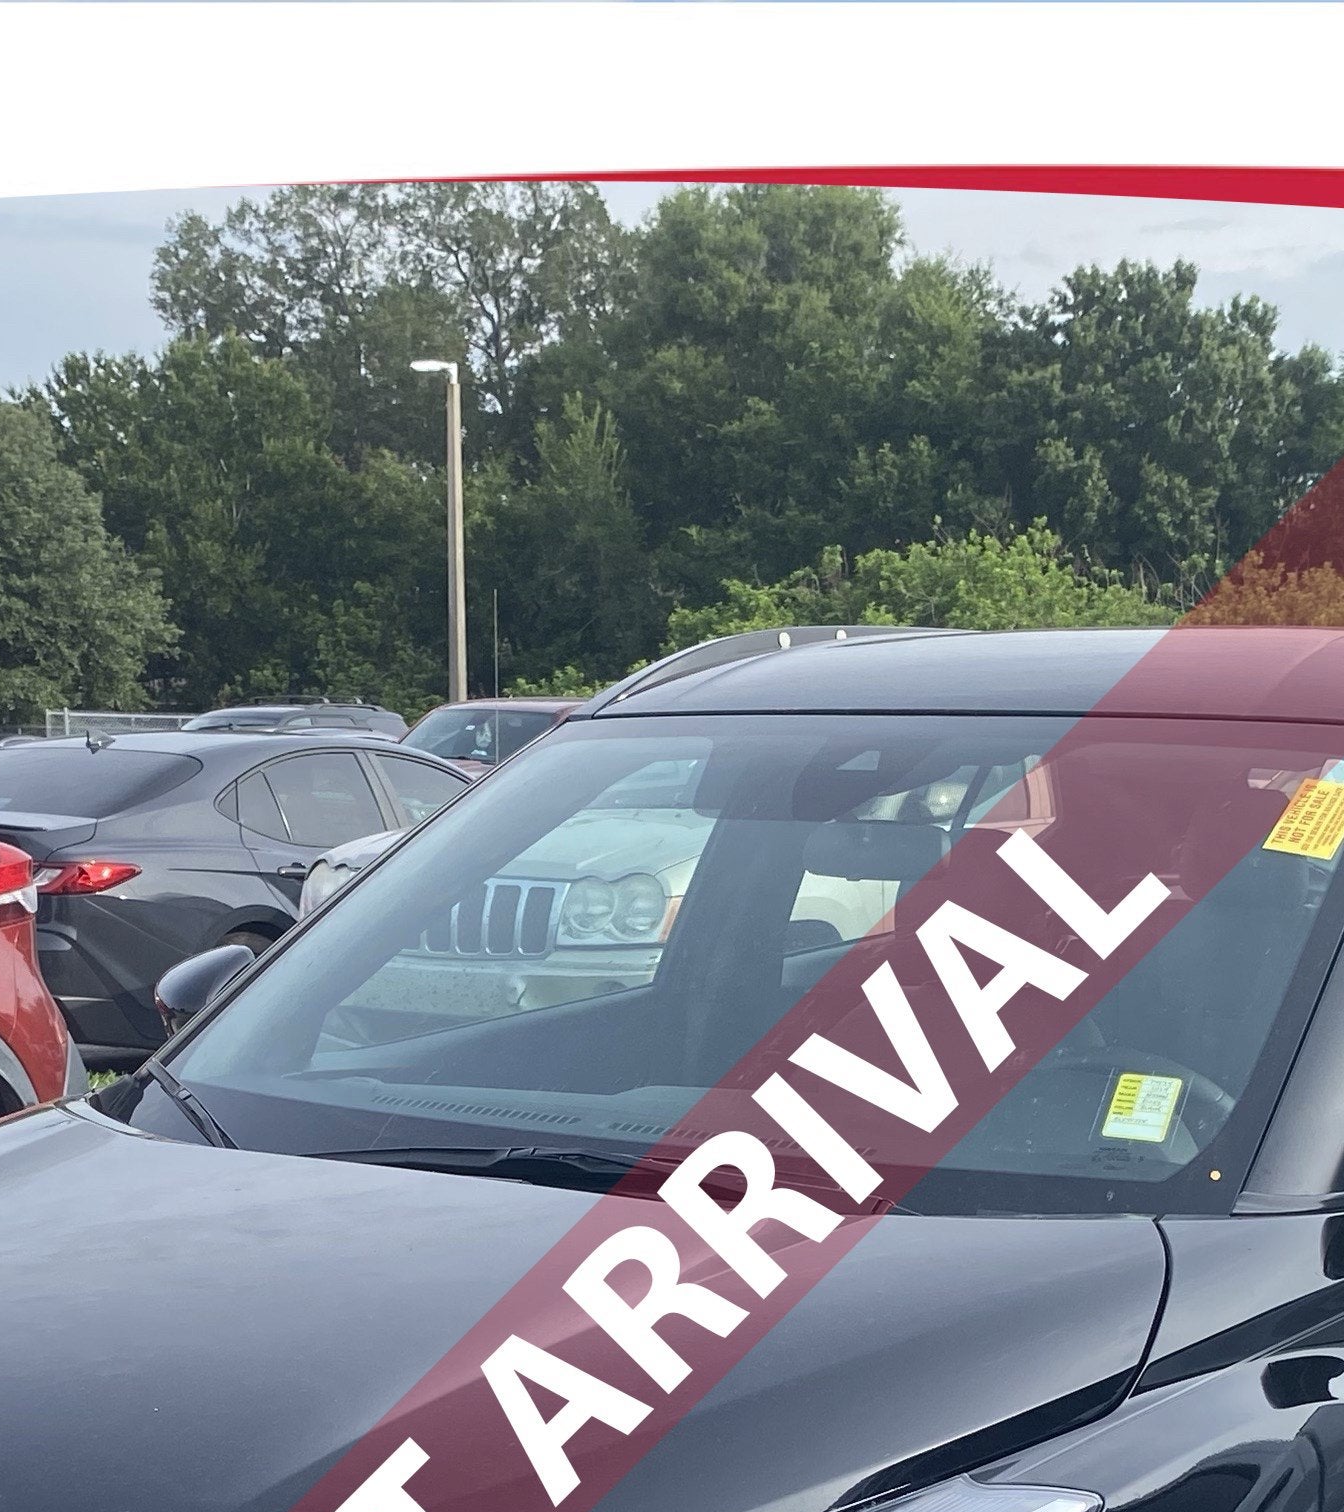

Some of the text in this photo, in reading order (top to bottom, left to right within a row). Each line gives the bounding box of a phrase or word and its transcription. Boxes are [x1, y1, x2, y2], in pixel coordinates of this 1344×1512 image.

[1270, 824, 1291, 844] THIS
[1284, 793, 1311, 825] VEHICLE
[1287, 826, 1307, 844] NOT
[1298, 809, 1318, 826] FOR
[1308, 788, 1330, 810] SALE
